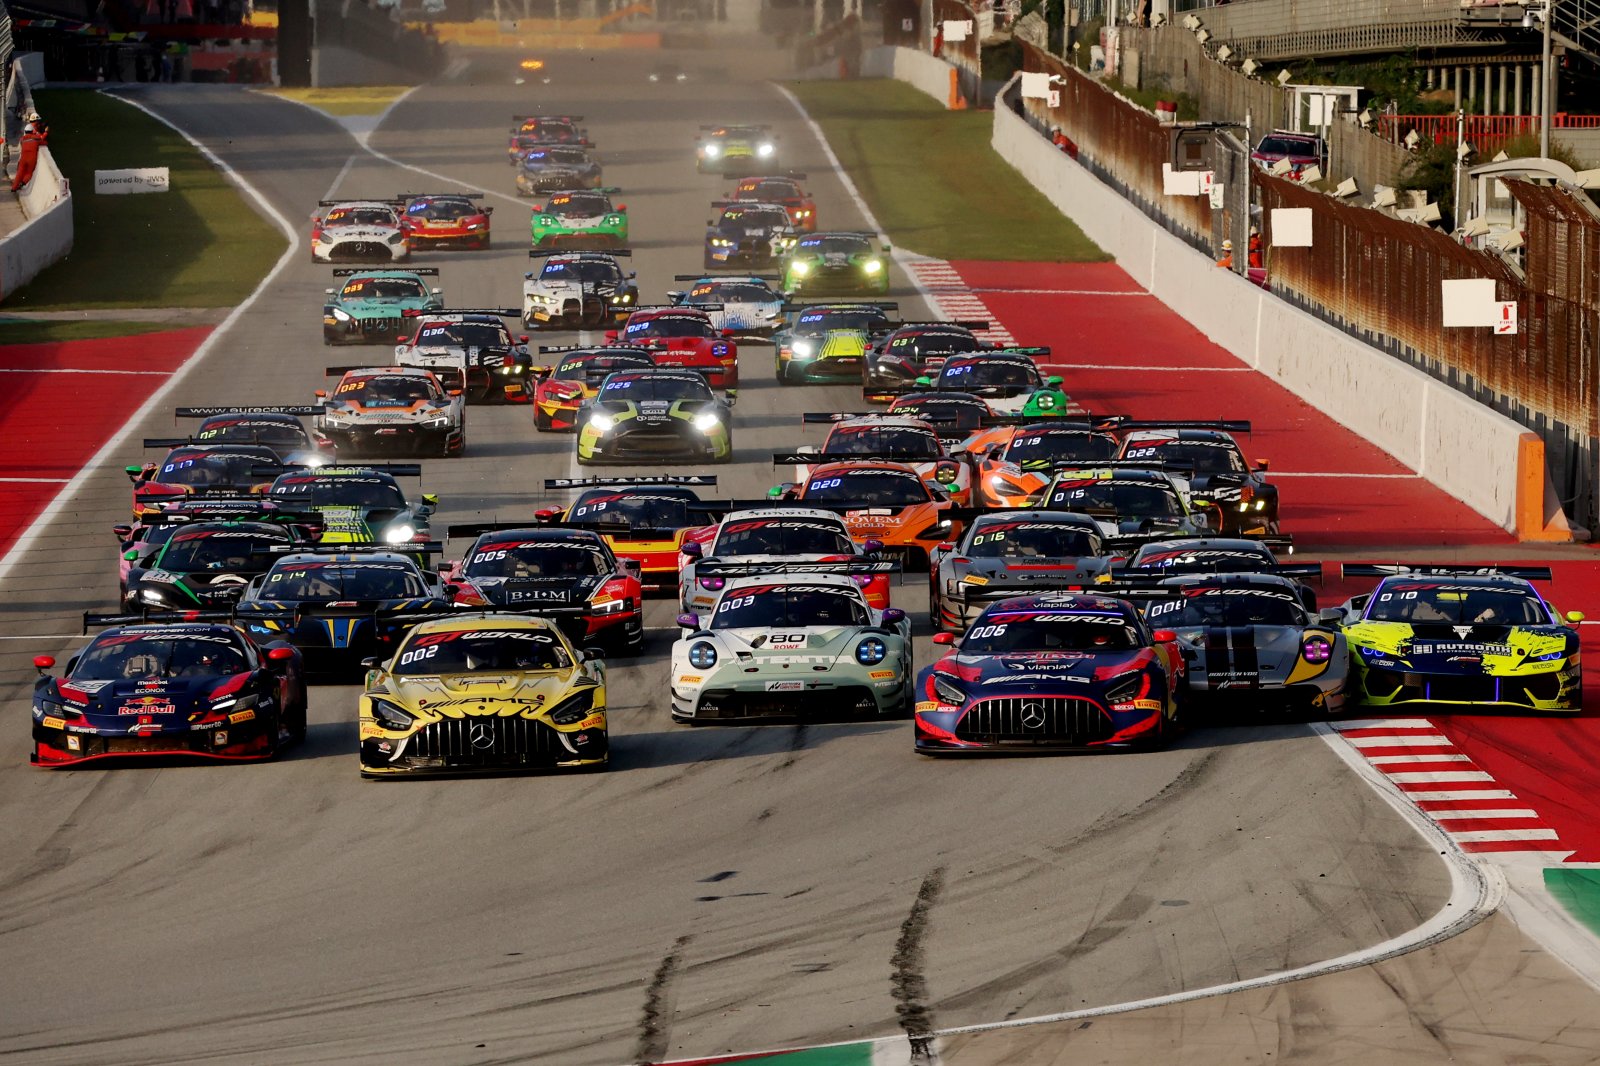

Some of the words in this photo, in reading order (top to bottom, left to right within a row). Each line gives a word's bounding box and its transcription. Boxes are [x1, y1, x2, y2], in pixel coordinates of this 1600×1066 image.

[98, 176, 133, 186] powered
[134, 175, 143, 184] by
[765, 521, 842, 533] WORLD
[1016, 523, 1094, 534] WORLD
[518, 542, 600, 551] WORLD
[473, 550, 508, 564] 005
[770, 585, 860, 599] WORLD
[1202, 588, 1294, 601] WORLD
[1437, 585, 1527, 595] WORLD
[719, 595, 755, 614] 003
[1032, 601, 1078, 610] viaplay
[1033, 614, 1126, 626] WORLD
[460, 631, 553, 644] WORLD
[969, 623, 1008, 640] 006
[140, 635, 232, 644] WORLD
[769, 633, 806, 644] 80
[1436, 643, 1513, 654] RUTRONIK
[400, 645, 439, 666] 002
[117, 706, 147, 716] Red
[147, 704, 176, 715] Bull
